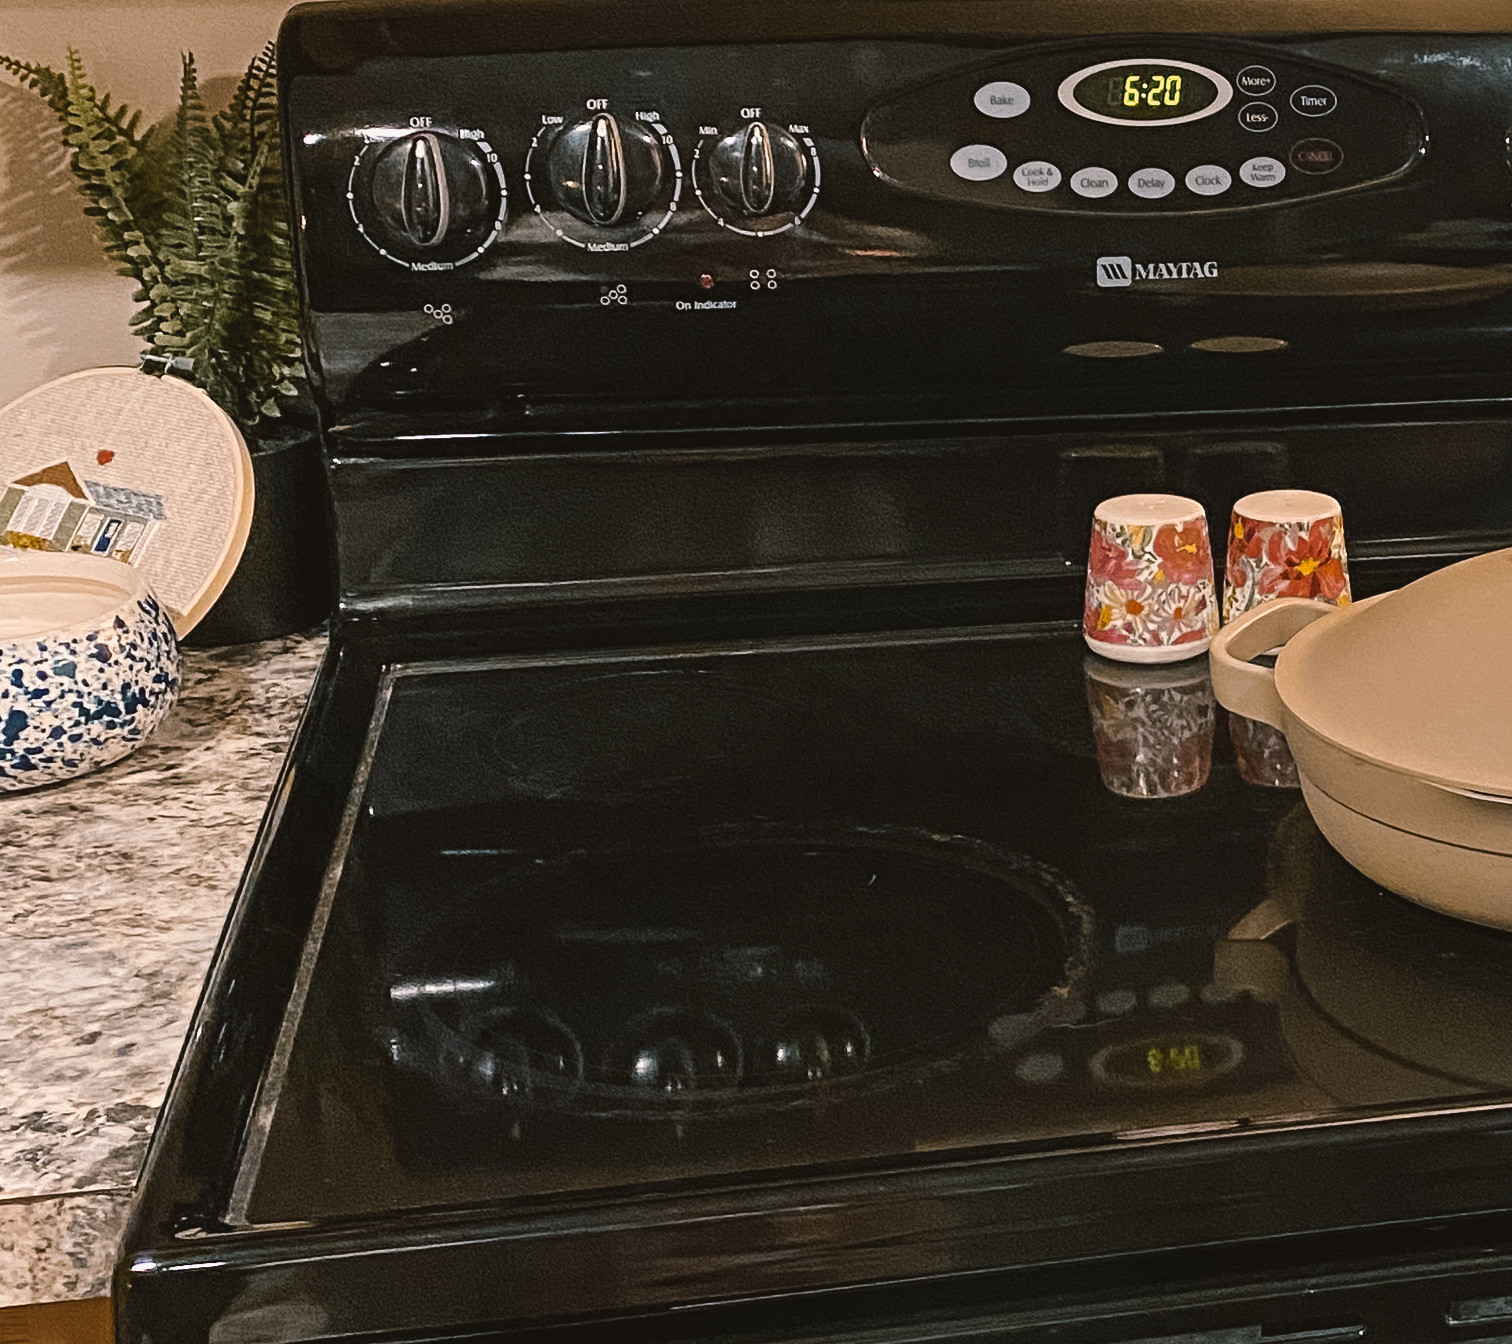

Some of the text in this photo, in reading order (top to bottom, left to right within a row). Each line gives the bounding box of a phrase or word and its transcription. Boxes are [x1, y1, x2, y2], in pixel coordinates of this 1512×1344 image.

[1123, 75, 1182, 106] 6:20
[586, 98, 608, 110] OFF
[990, 94, 1015, 105] Bake
[1301, 95, 1327, 106] Timer
[635, 111, 660, 123] High
[740, 107, 762, 119] OFF
[409, 117, 432, 128] OFF
[541, 114, 564, 125] Low
[699, 125, 718, 136] Min
[788, 124, 809, 134] Max
[531, 136, 538, 147] 2
[661, 134, 674, 145] 10
[486, 153, 498, 163] 10
[1080, 177, 1109, 189] Clean
[1137, 177, 1165, 190] Delay
[1195, 175, 1222, 186] Clock
[1250, 173, 1276, 183] Warm
[587, 242, 629, 252] Medium
[411, 261, 454, 272] Medium
[1134, 261, 1218, 280] MAYTAG
[675, 300, 737, 310] On Indicator
